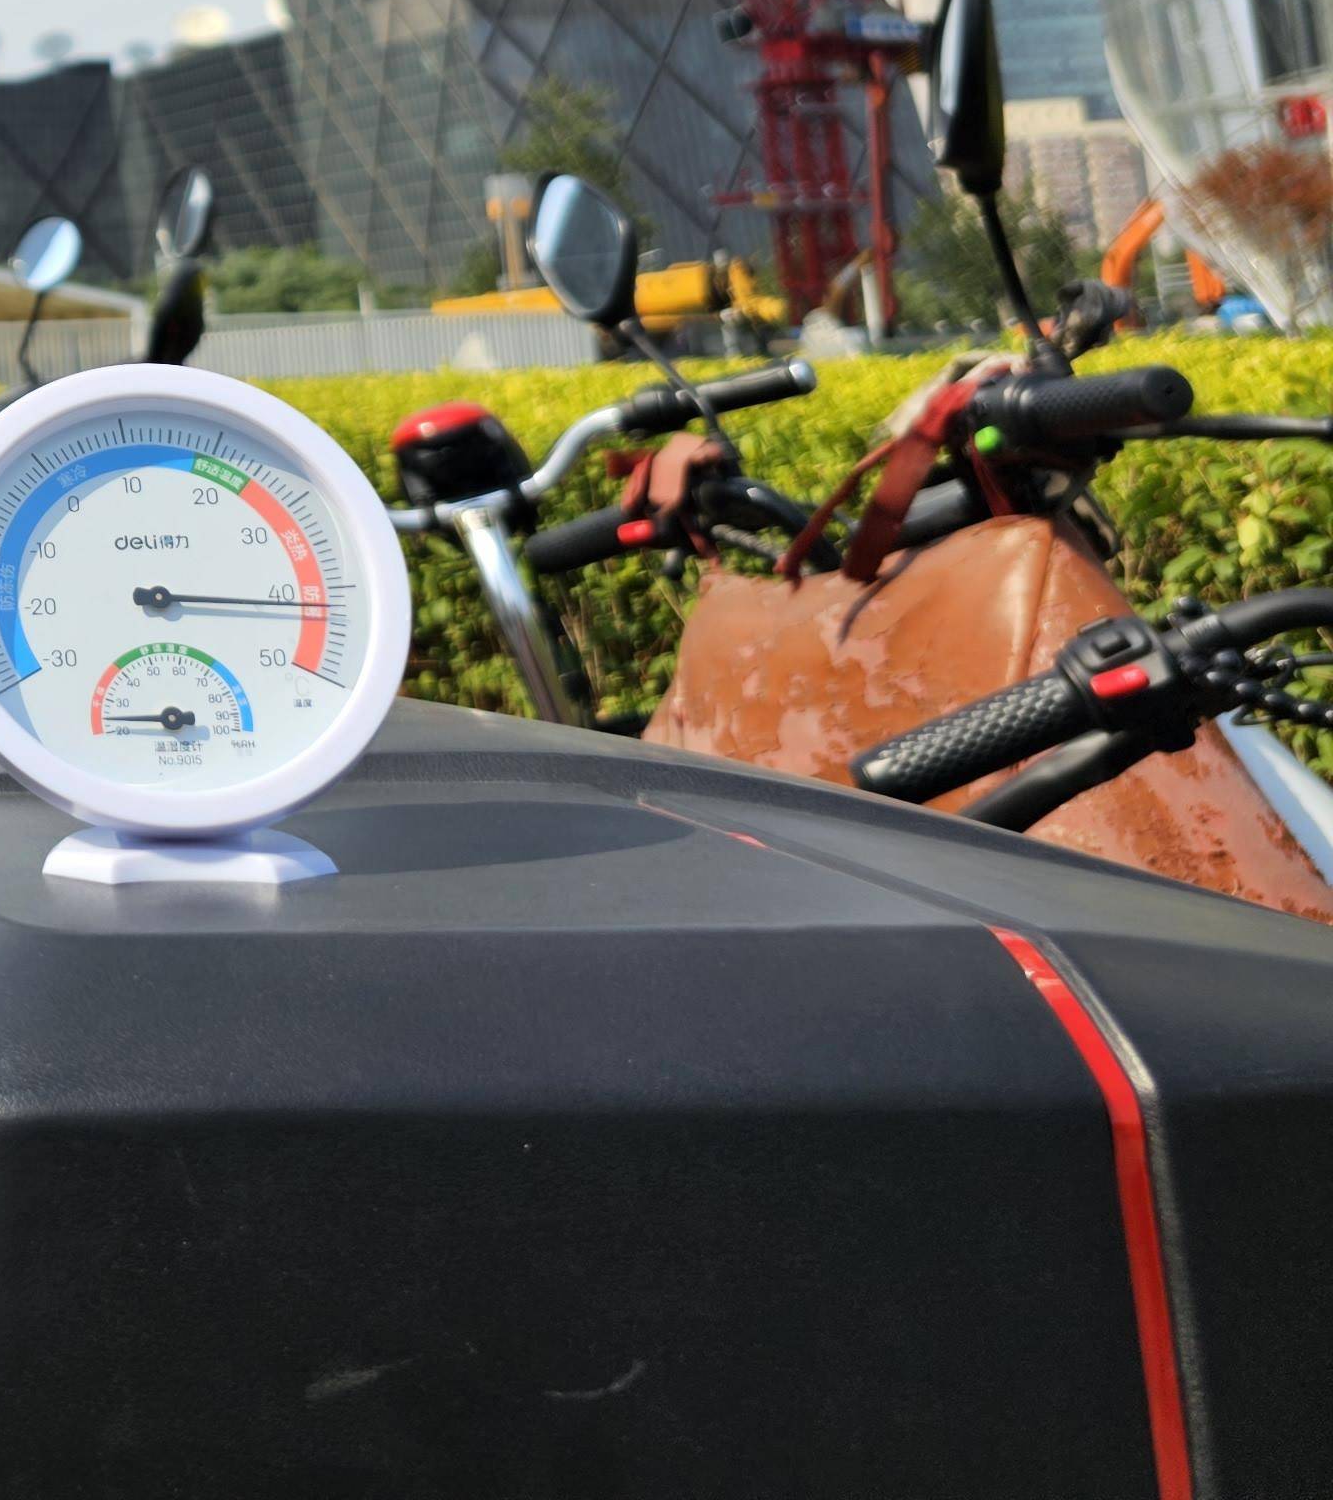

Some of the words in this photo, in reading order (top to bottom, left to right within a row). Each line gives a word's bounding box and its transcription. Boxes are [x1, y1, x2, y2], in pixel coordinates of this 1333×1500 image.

[122, 476, 142, 494] 10
[67, 495, 80, 513] 0
[192, 487, 219, 505] 20
[240, 527, 268, 545] 30
[280, 529, 308, 561] 炎热
[29, 541, 56, 559] -10
[268, 583, 295, 603] 40
[24, 598, 57, 616] -20
[42, 649, 77, 668] -30
[259, 648, 286, 667] 50
[146, 666, 161, 676] 50
[172, 666, 186, 676] 60
[126, 677, 141, 688] 40
[196, 677, 209, 688] 70
[116, 698, 130, 708] 30
[208, 693, 223, 704] 80
[215, 711, 230, 721] 90
[115, 726, 131, 736] 20
[212, 725, 230, 735] 100
